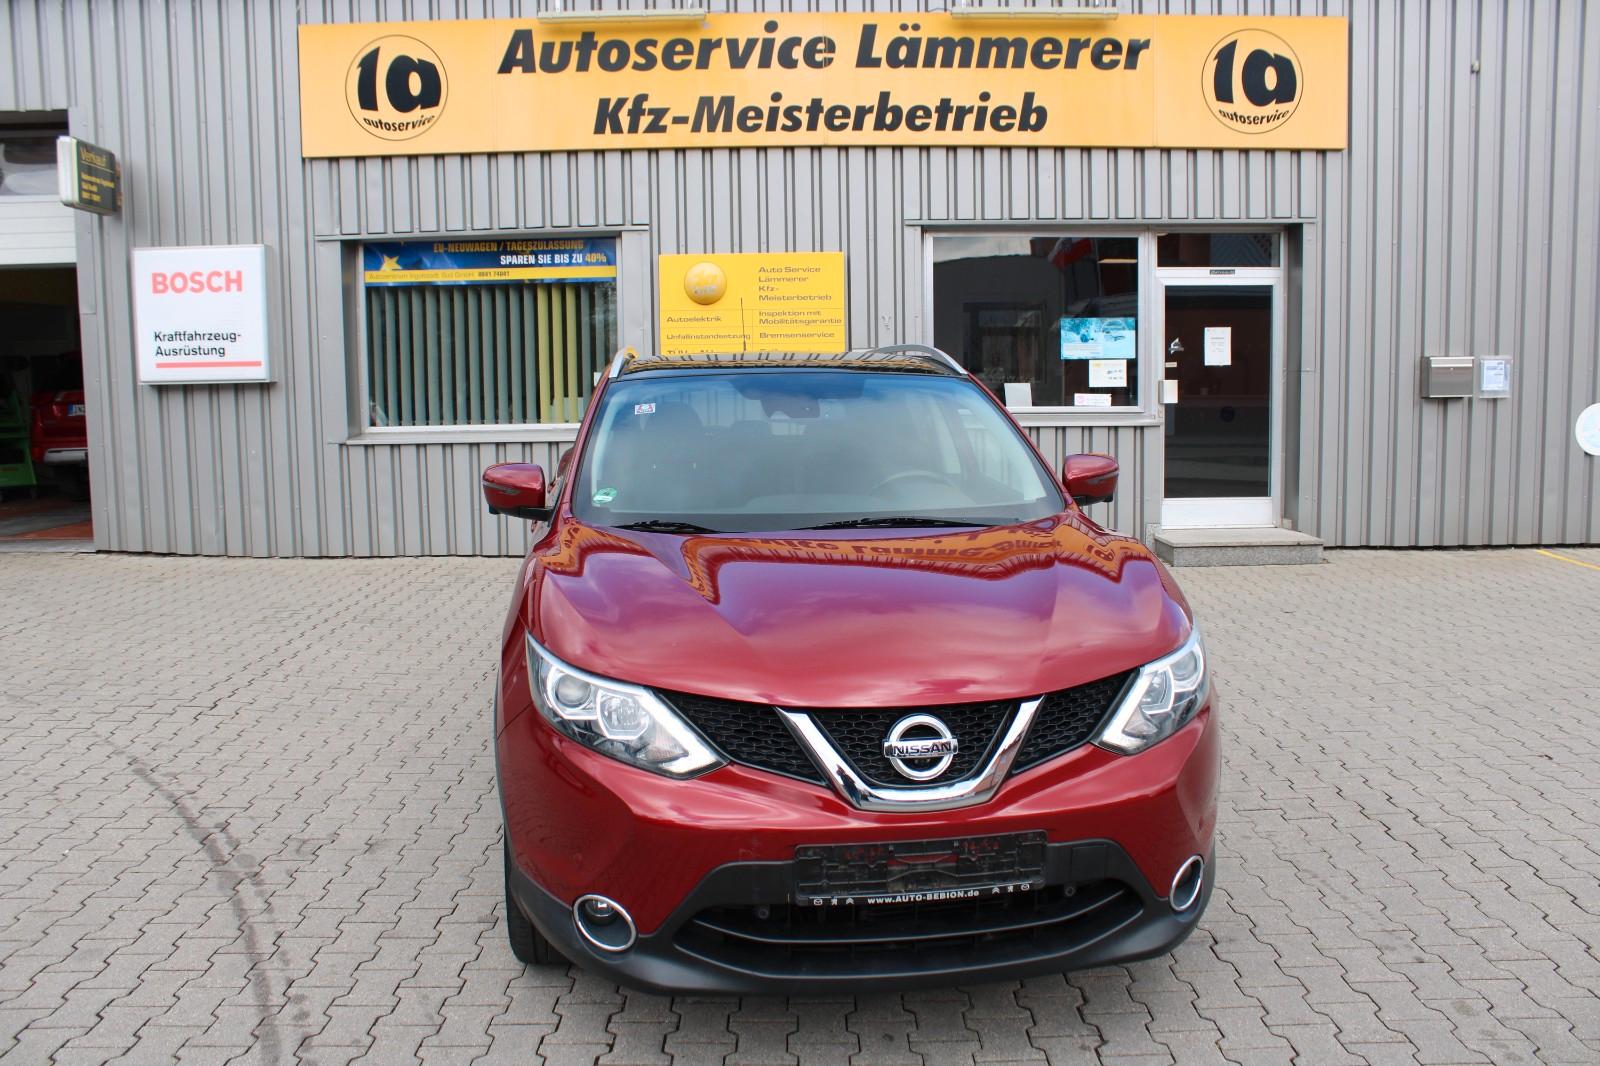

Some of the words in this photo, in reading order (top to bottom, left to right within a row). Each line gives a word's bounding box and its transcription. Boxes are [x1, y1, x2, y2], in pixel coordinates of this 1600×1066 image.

[497, 20, 836, 74] Autoservice
[855, 22, 1151, 71] Lämmerer
[357, 46, 442, 113] 1a
[1213, 39, 1297, 107] 1a
[593, 91, 1048, 135] Kfz-Meisterbetrieb
[1218, 109, 1290, 126] autoservice
[363, 114, 436, 132] autoservice
[433, 242, 498, 253] EU-NEUWAGEN
[506, 240, 584, 252] TAGESZULASSUNG
[500, 254, 536, 265] SPAREN
[537, 254, 552, 264] SIE
[554, 253, 570, 264] BIS
[571, 253, 583, 263] ZU
[585, 252, 607, 263] 40%
[151, 270, 243, 294] BOSCH
[758, 275, 809, 283] Lämmerer
[666, 315, 722, 323] Autoelektrik
[759, 310, 806, 318] Inspektion
[759, 318, 842, 326] Mobilitätsgarantie
[154, 329, 241, 343] Kraftfahrzeug-
[759, 331, 835, 339] Bremsenservice
[155, 344, 226, 358] Ausrüstung
[893, 740, 952, 755] NISSAN
[867, 889, 980, 905] www.AUTO-BEBION.de
